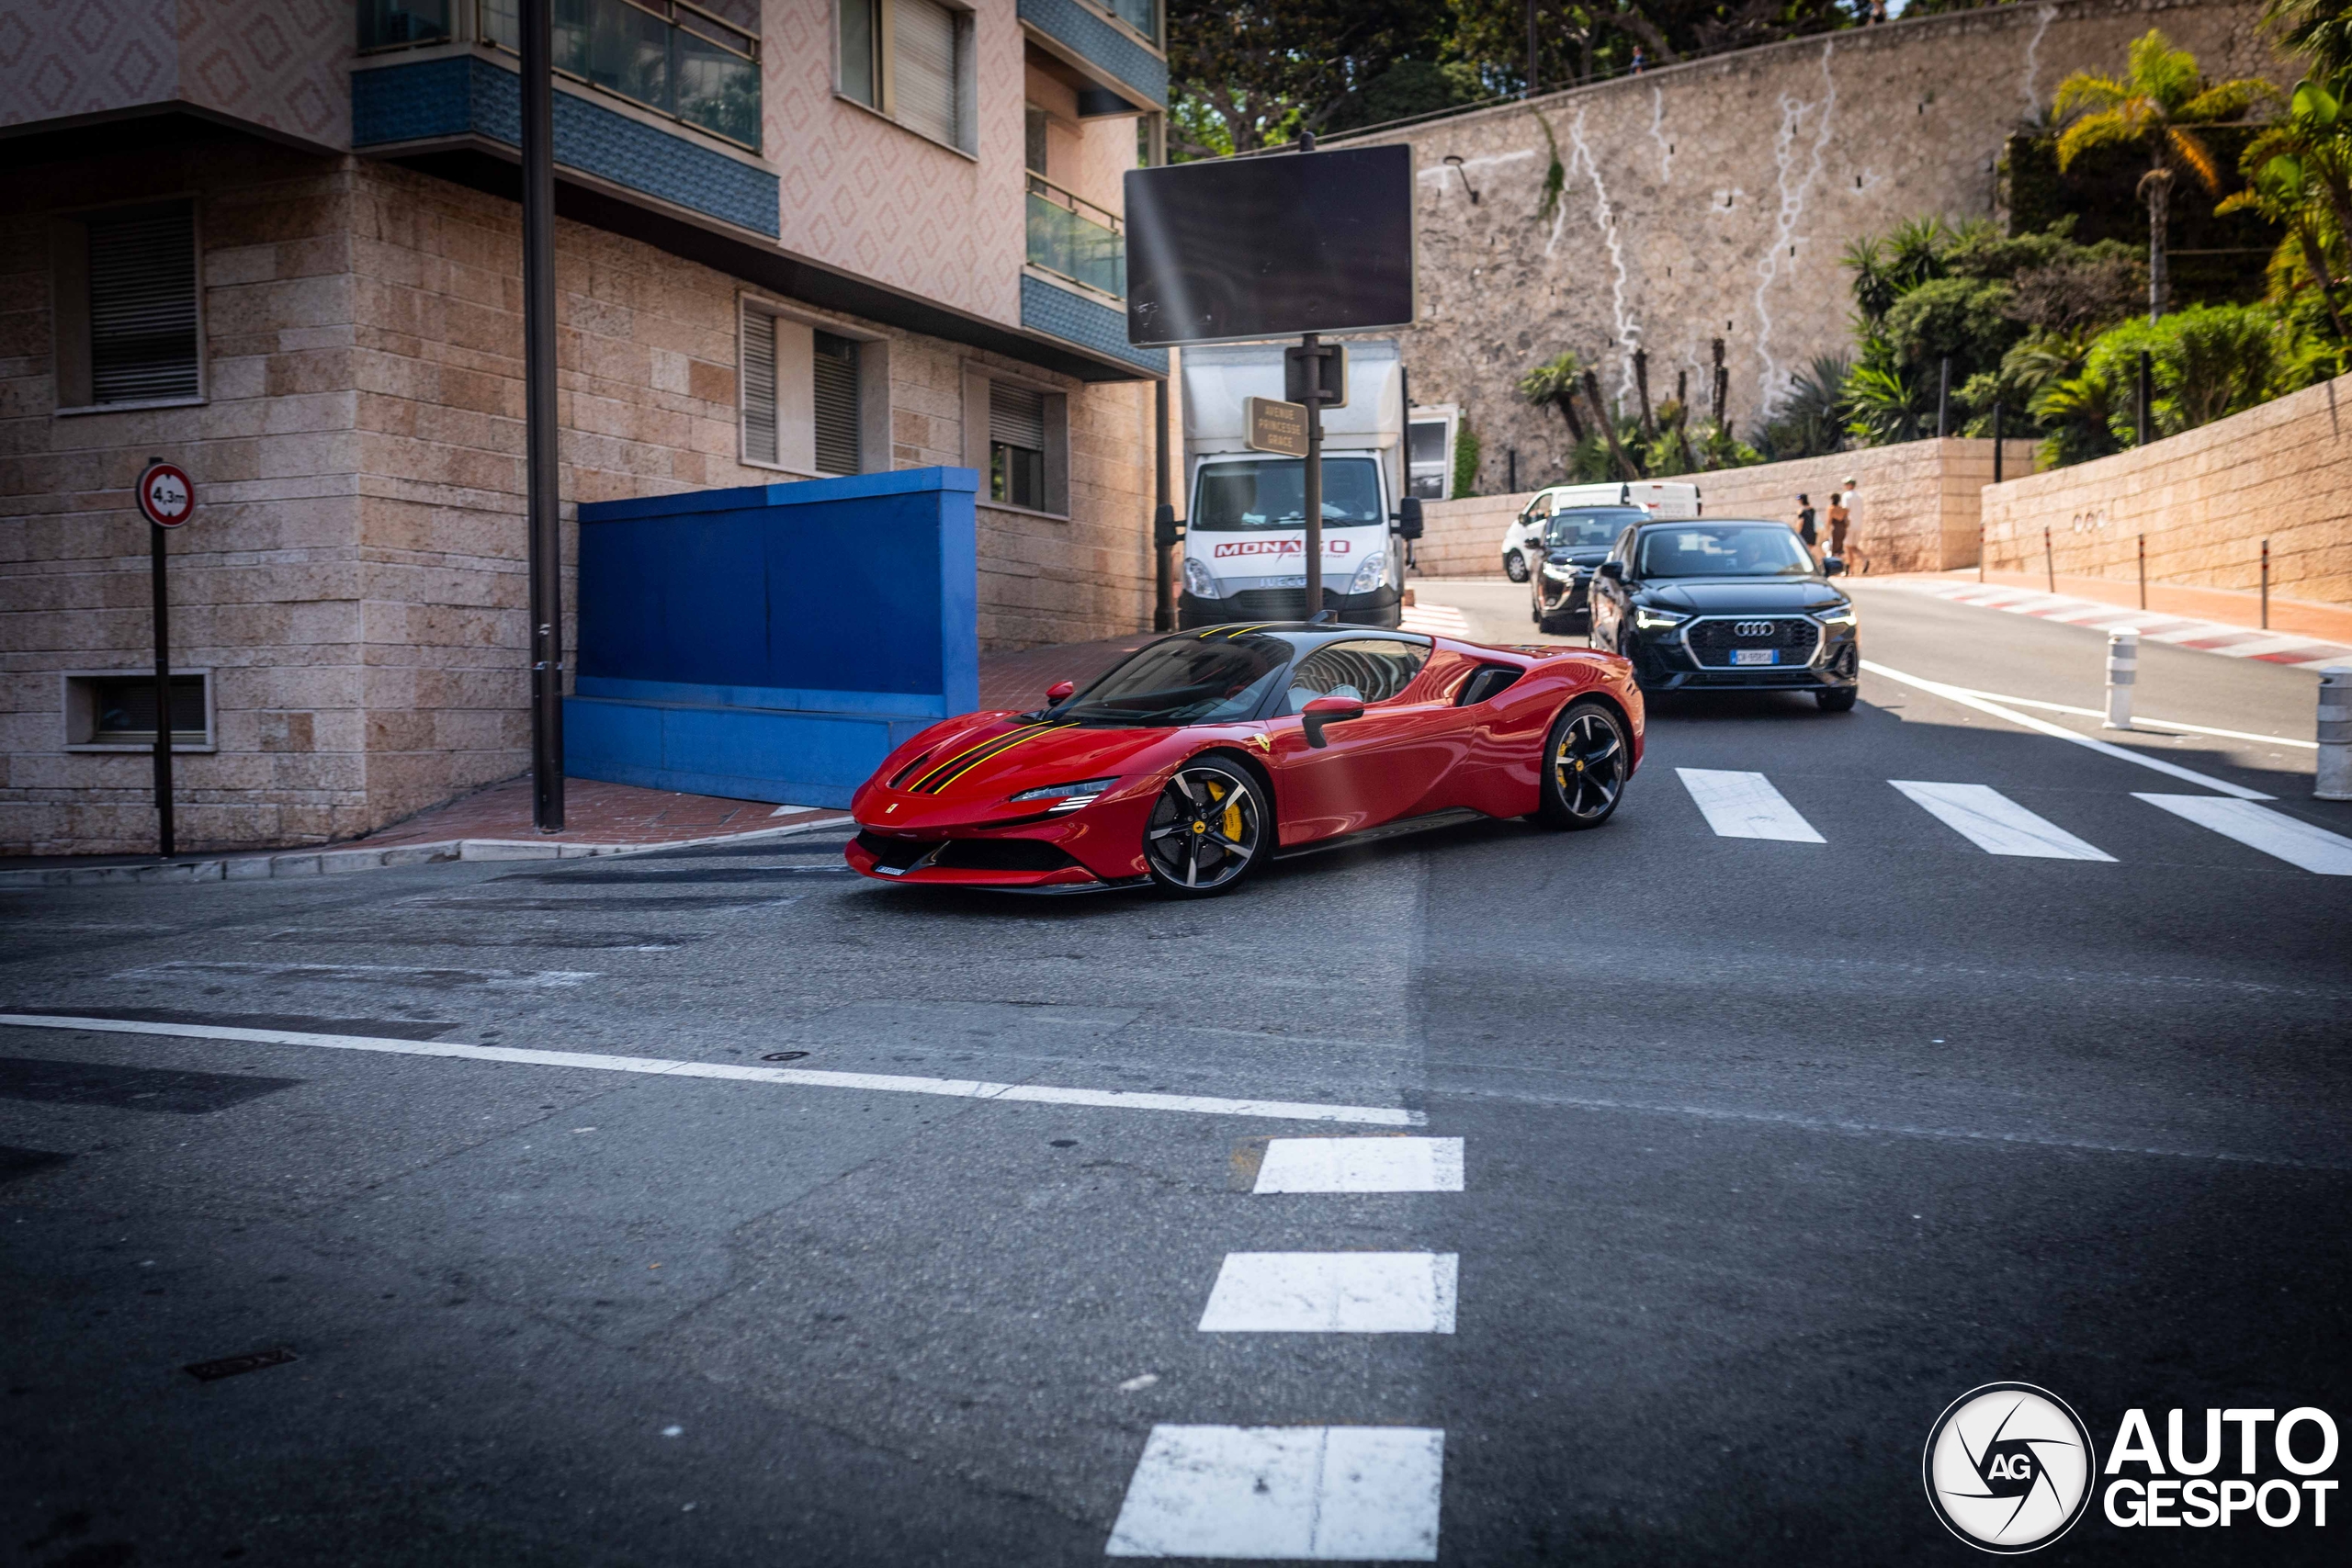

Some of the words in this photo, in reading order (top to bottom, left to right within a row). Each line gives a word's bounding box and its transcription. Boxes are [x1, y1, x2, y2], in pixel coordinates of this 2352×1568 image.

[1265, 405, 1295, 420] AVENUE
[1259, 418, 1301, 435] PRINCESSE
[1268, 434, 1293, 447] GRACE
[1216, 540, 1350, 558] MONAO
